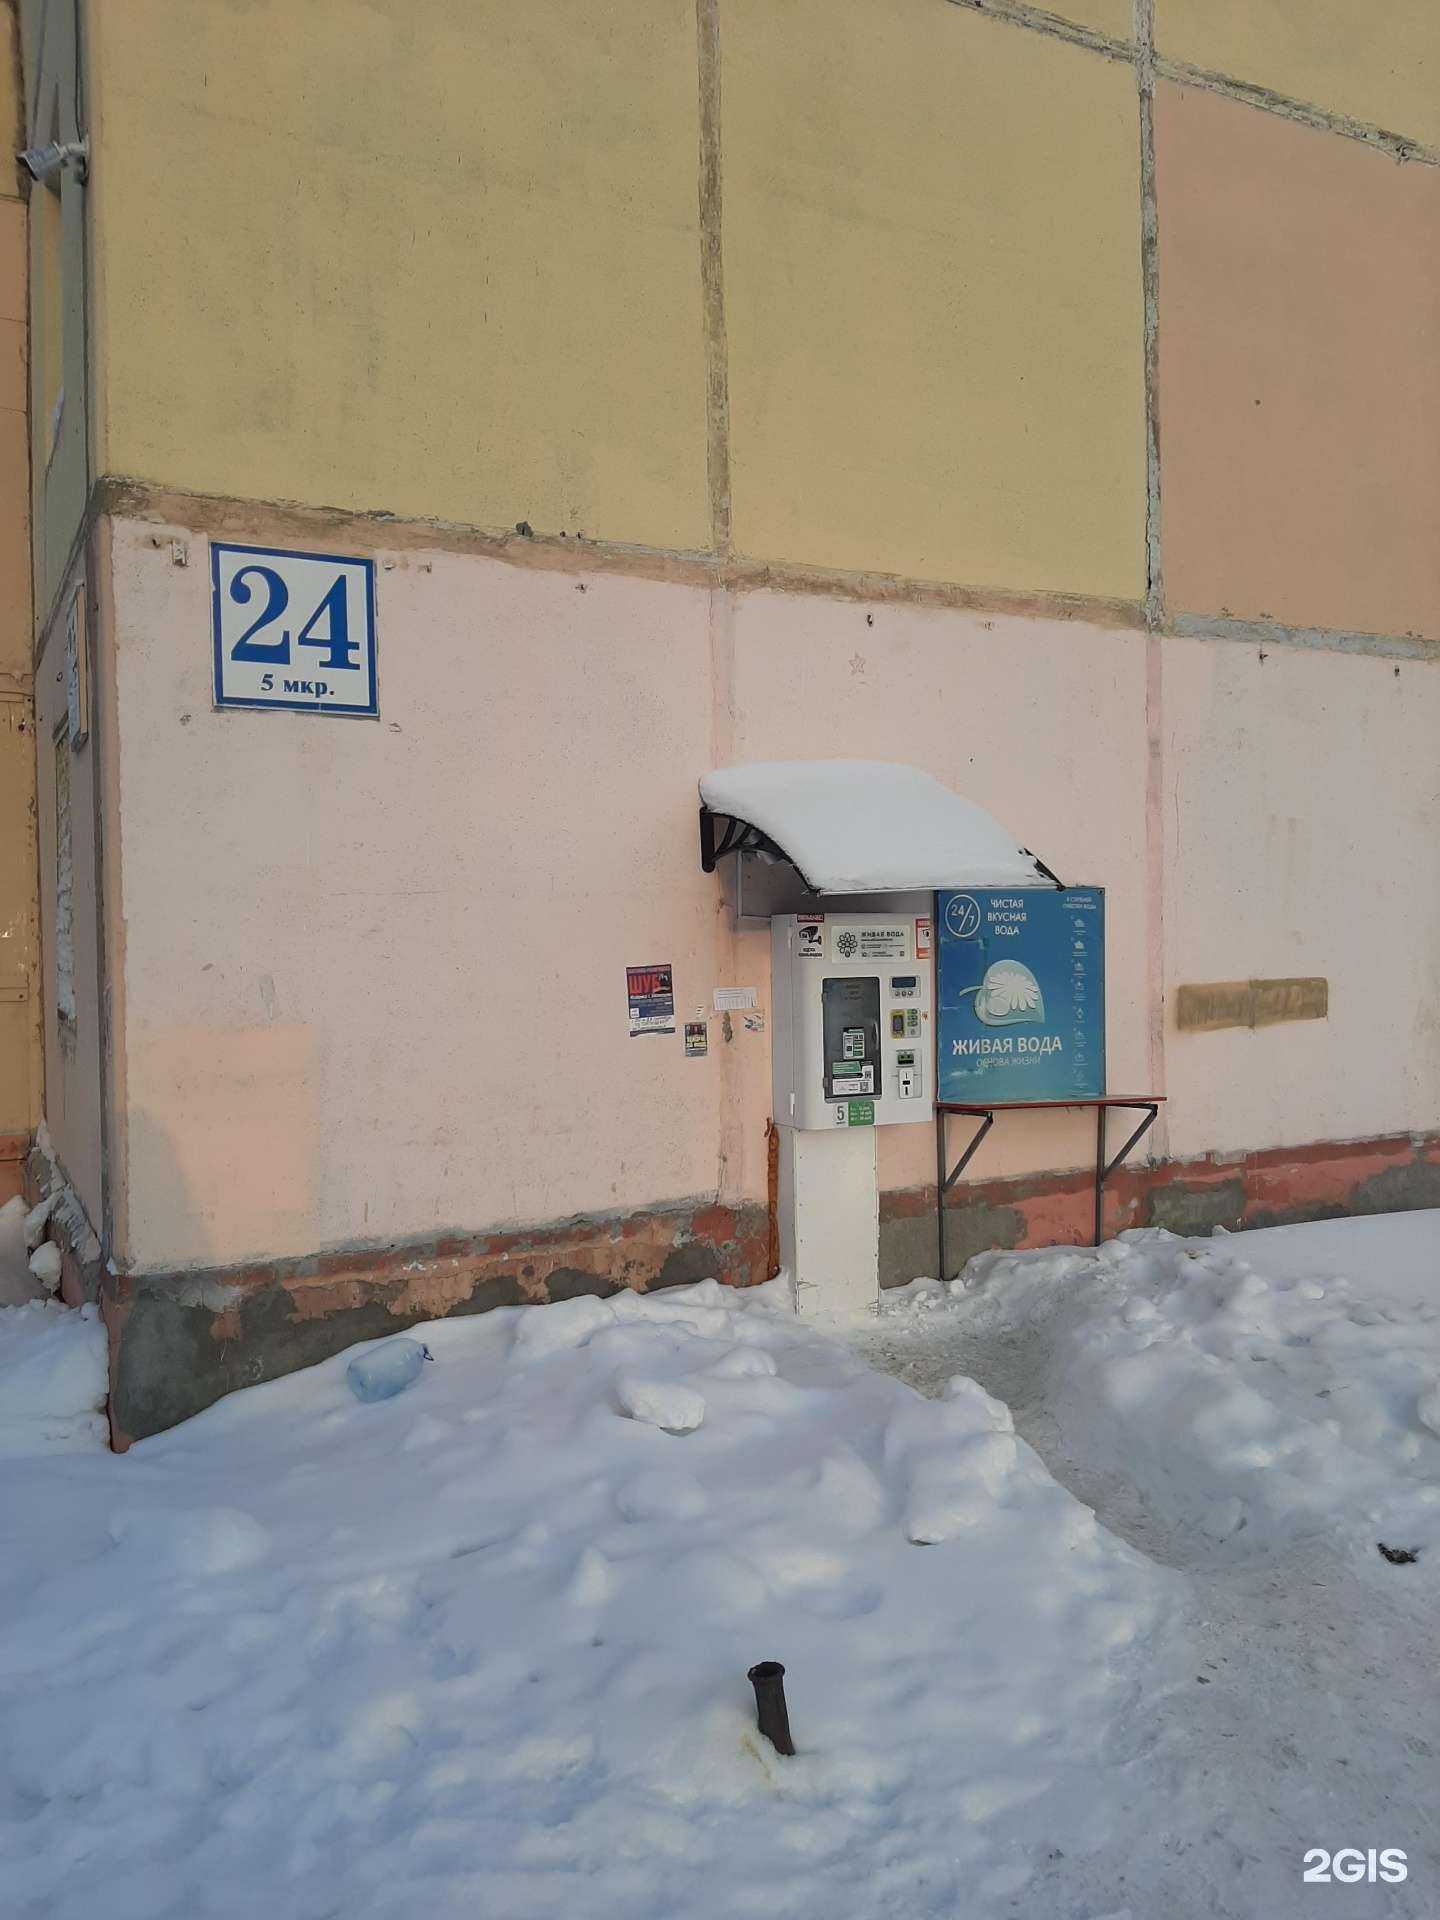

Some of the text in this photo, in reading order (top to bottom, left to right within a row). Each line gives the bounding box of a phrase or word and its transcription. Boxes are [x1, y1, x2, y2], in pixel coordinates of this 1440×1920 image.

[229, 565, 361, 671] 24
[260, 674, 335, 698] 5 мкр.
[990, 899, 1024, 909] ЧИСТАЯ
[951, 903, 975, 932] 24/7
[987, 912, 1027, 922] ВКУСНАЯ
[994, 925, 1020, 935] ВОДА
[952, 1036, 1062, 1055] ЖИВАЯ ВОДА
[837, 1105, 845, 1121] 5
